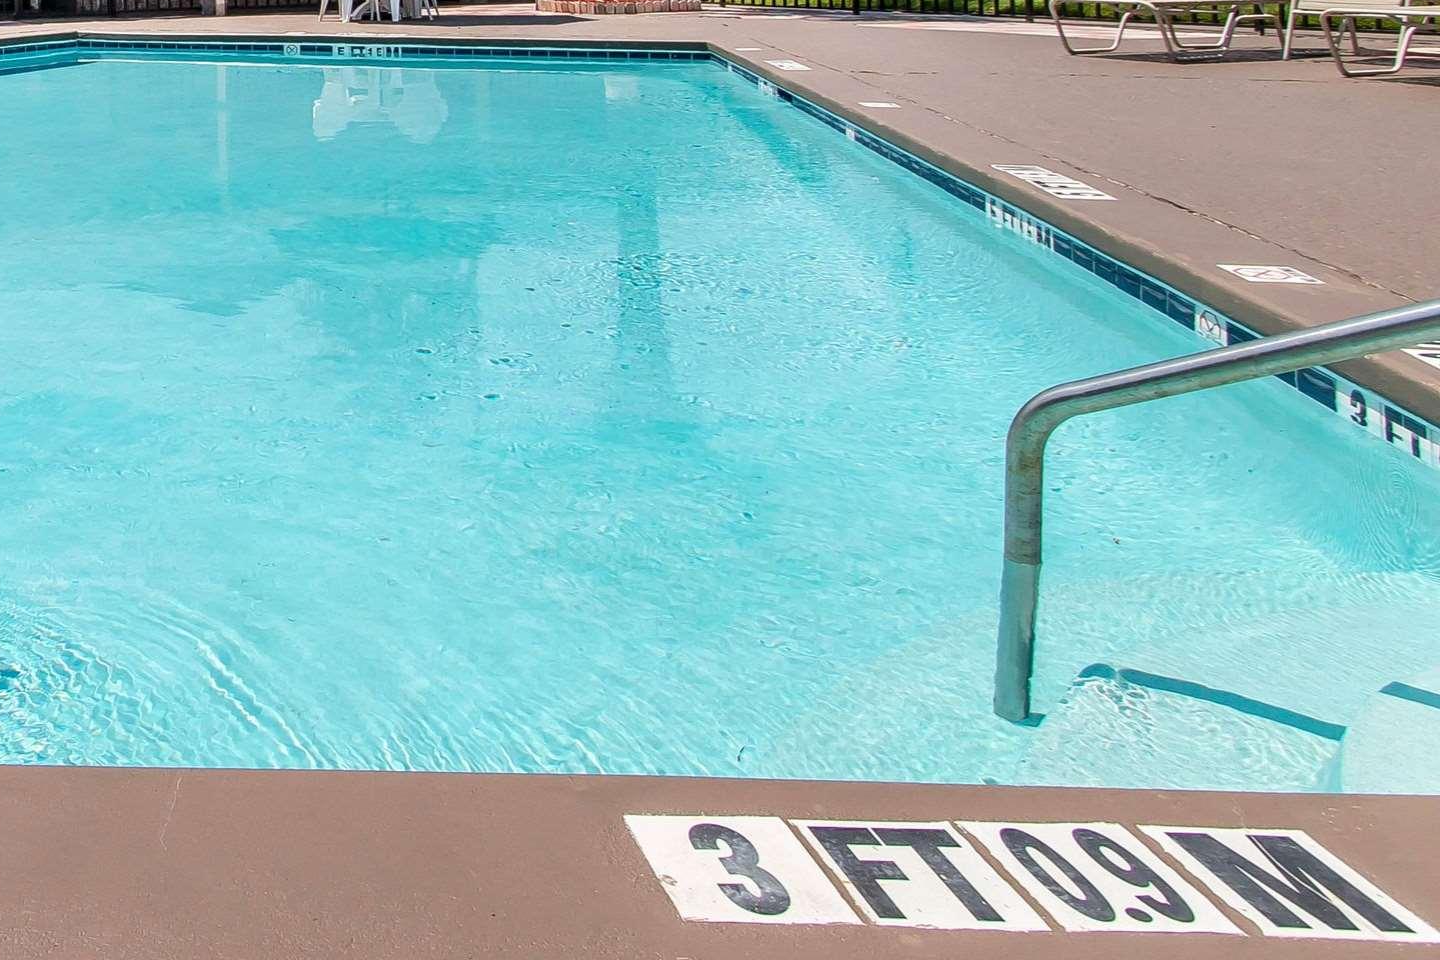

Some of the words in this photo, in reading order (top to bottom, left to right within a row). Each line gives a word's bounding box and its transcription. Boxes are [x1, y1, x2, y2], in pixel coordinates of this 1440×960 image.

[1350, 389, 1368, 427] 3
[1384, 404, 1428, 459] FT
[687, 823, 792, 917] 3
[807, 825, 1007, 924] FT
[997, 827, 1197, 925] 0.9
[1161, 831, 1419, 935] M
